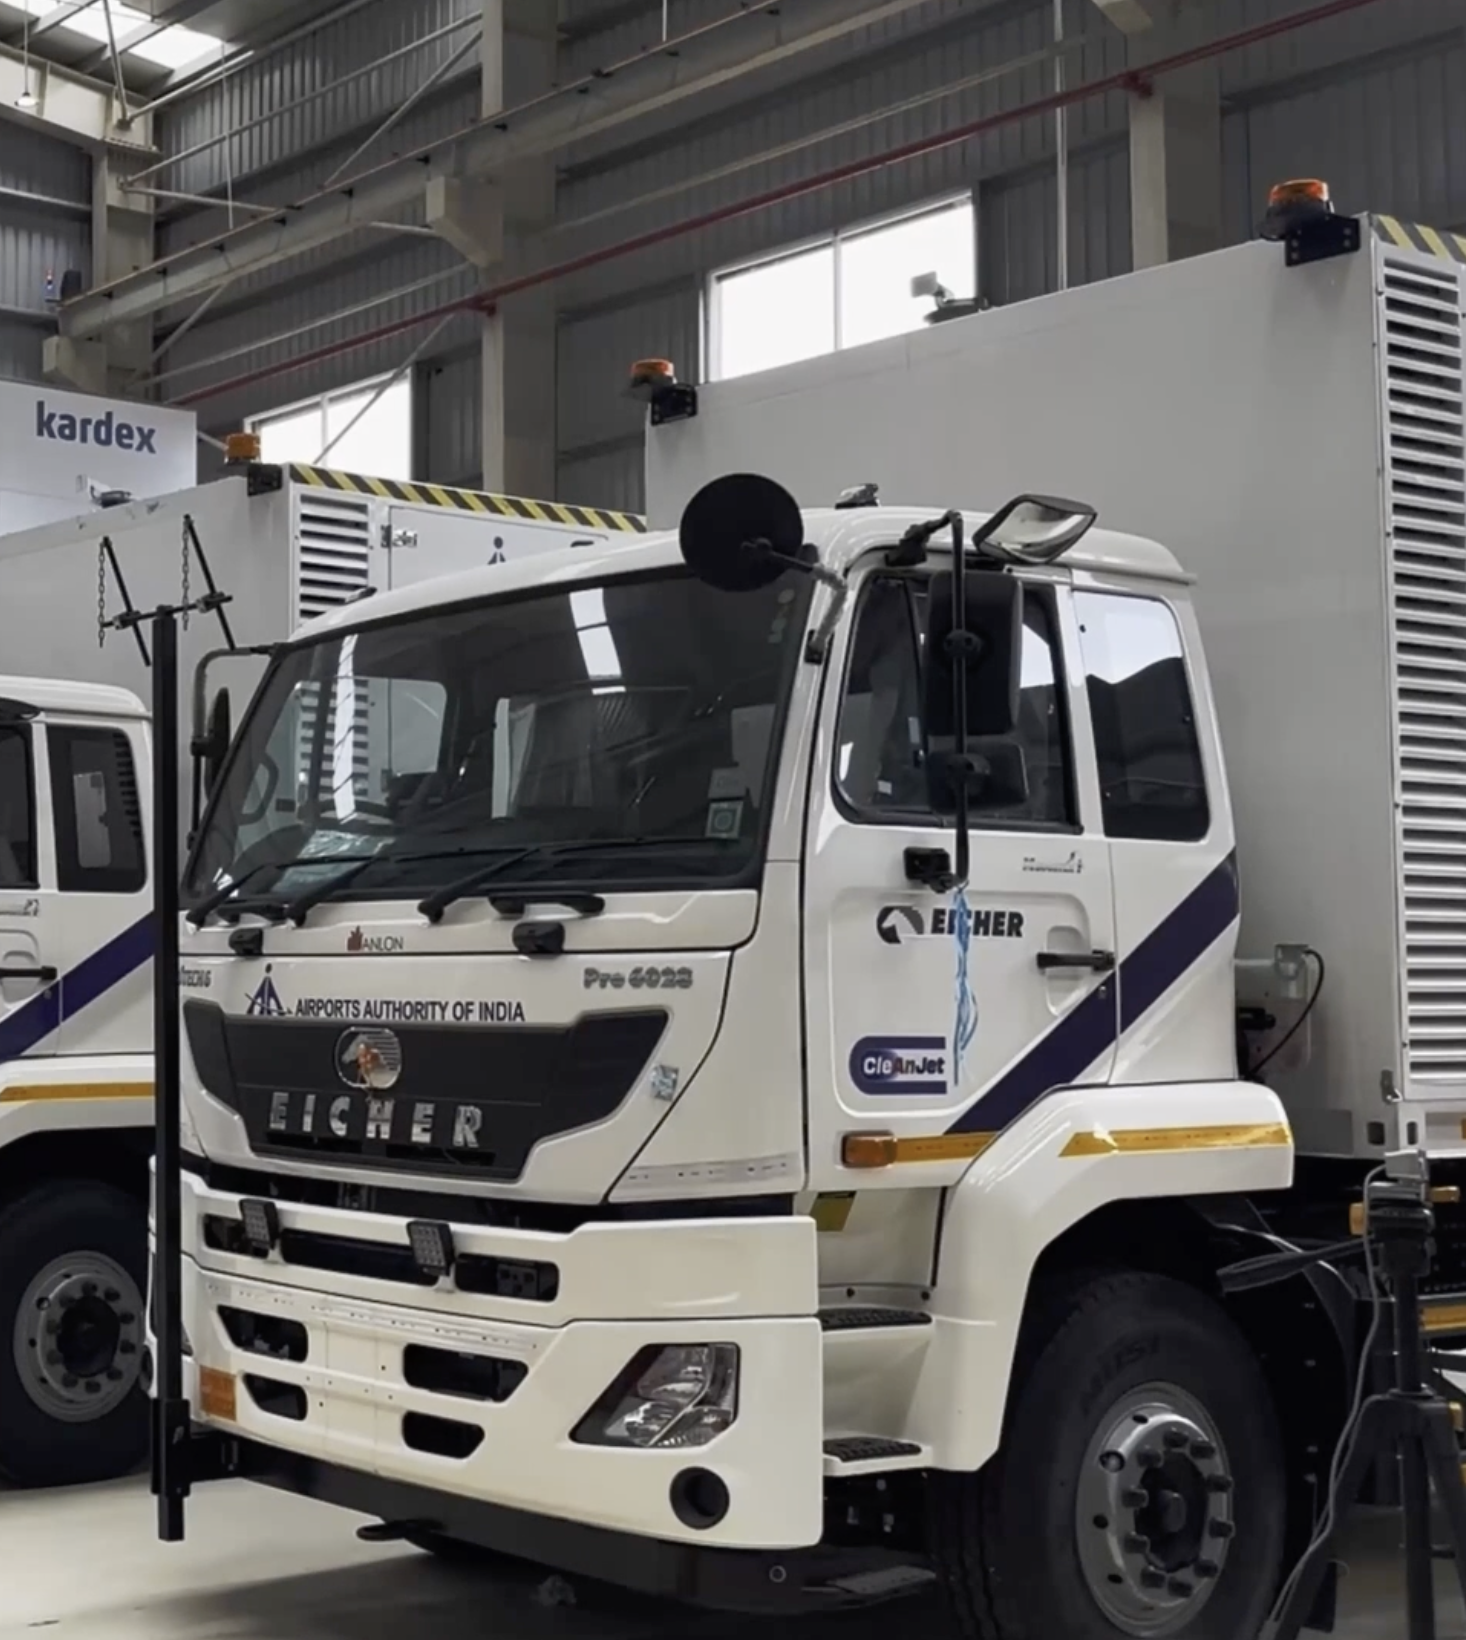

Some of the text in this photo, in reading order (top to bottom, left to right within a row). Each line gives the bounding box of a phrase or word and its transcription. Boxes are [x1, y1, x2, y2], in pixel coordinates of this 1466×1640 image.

[36, 401, 156, 453] kardex
[584, 967, 625, 989] Pro
[295, 999, 525, 1022] AIRPORTS AUTHORITY OF INDIA
[863, 1056, 945, 1076] CleAnJet
[269, 1092, 483, 1148] EICHER
